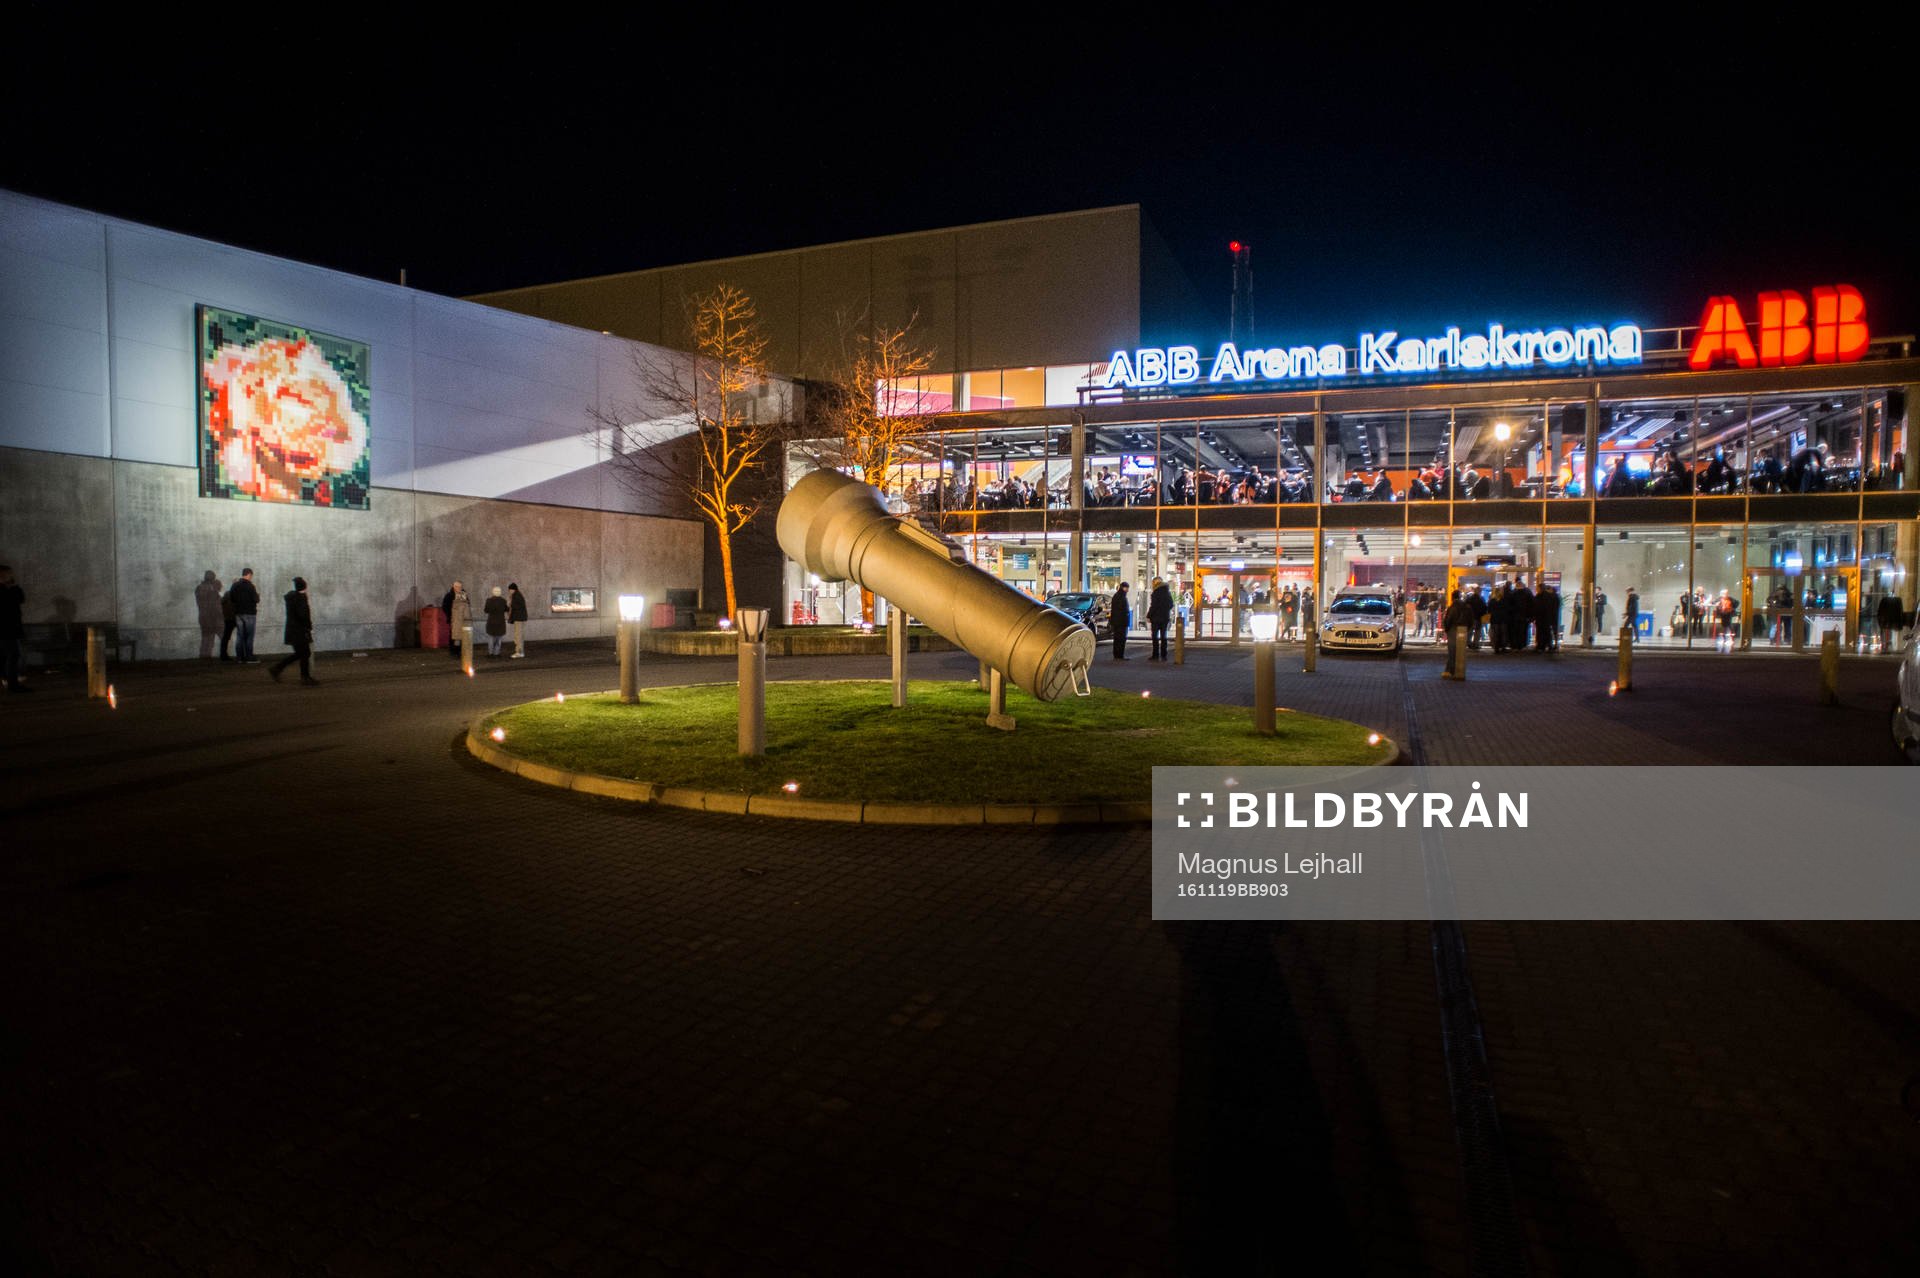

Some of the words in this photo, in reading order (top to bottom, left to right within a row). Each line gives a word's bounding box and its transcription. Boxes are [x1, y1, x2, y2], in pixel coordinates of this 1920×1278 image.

[1104, 345, 1199, 388] ABB
[1210, 342, 1346, 382] Arena
[1361, 323, 1642, 373] Karlskrona
[1690, 285, 1870, 370] ABB
